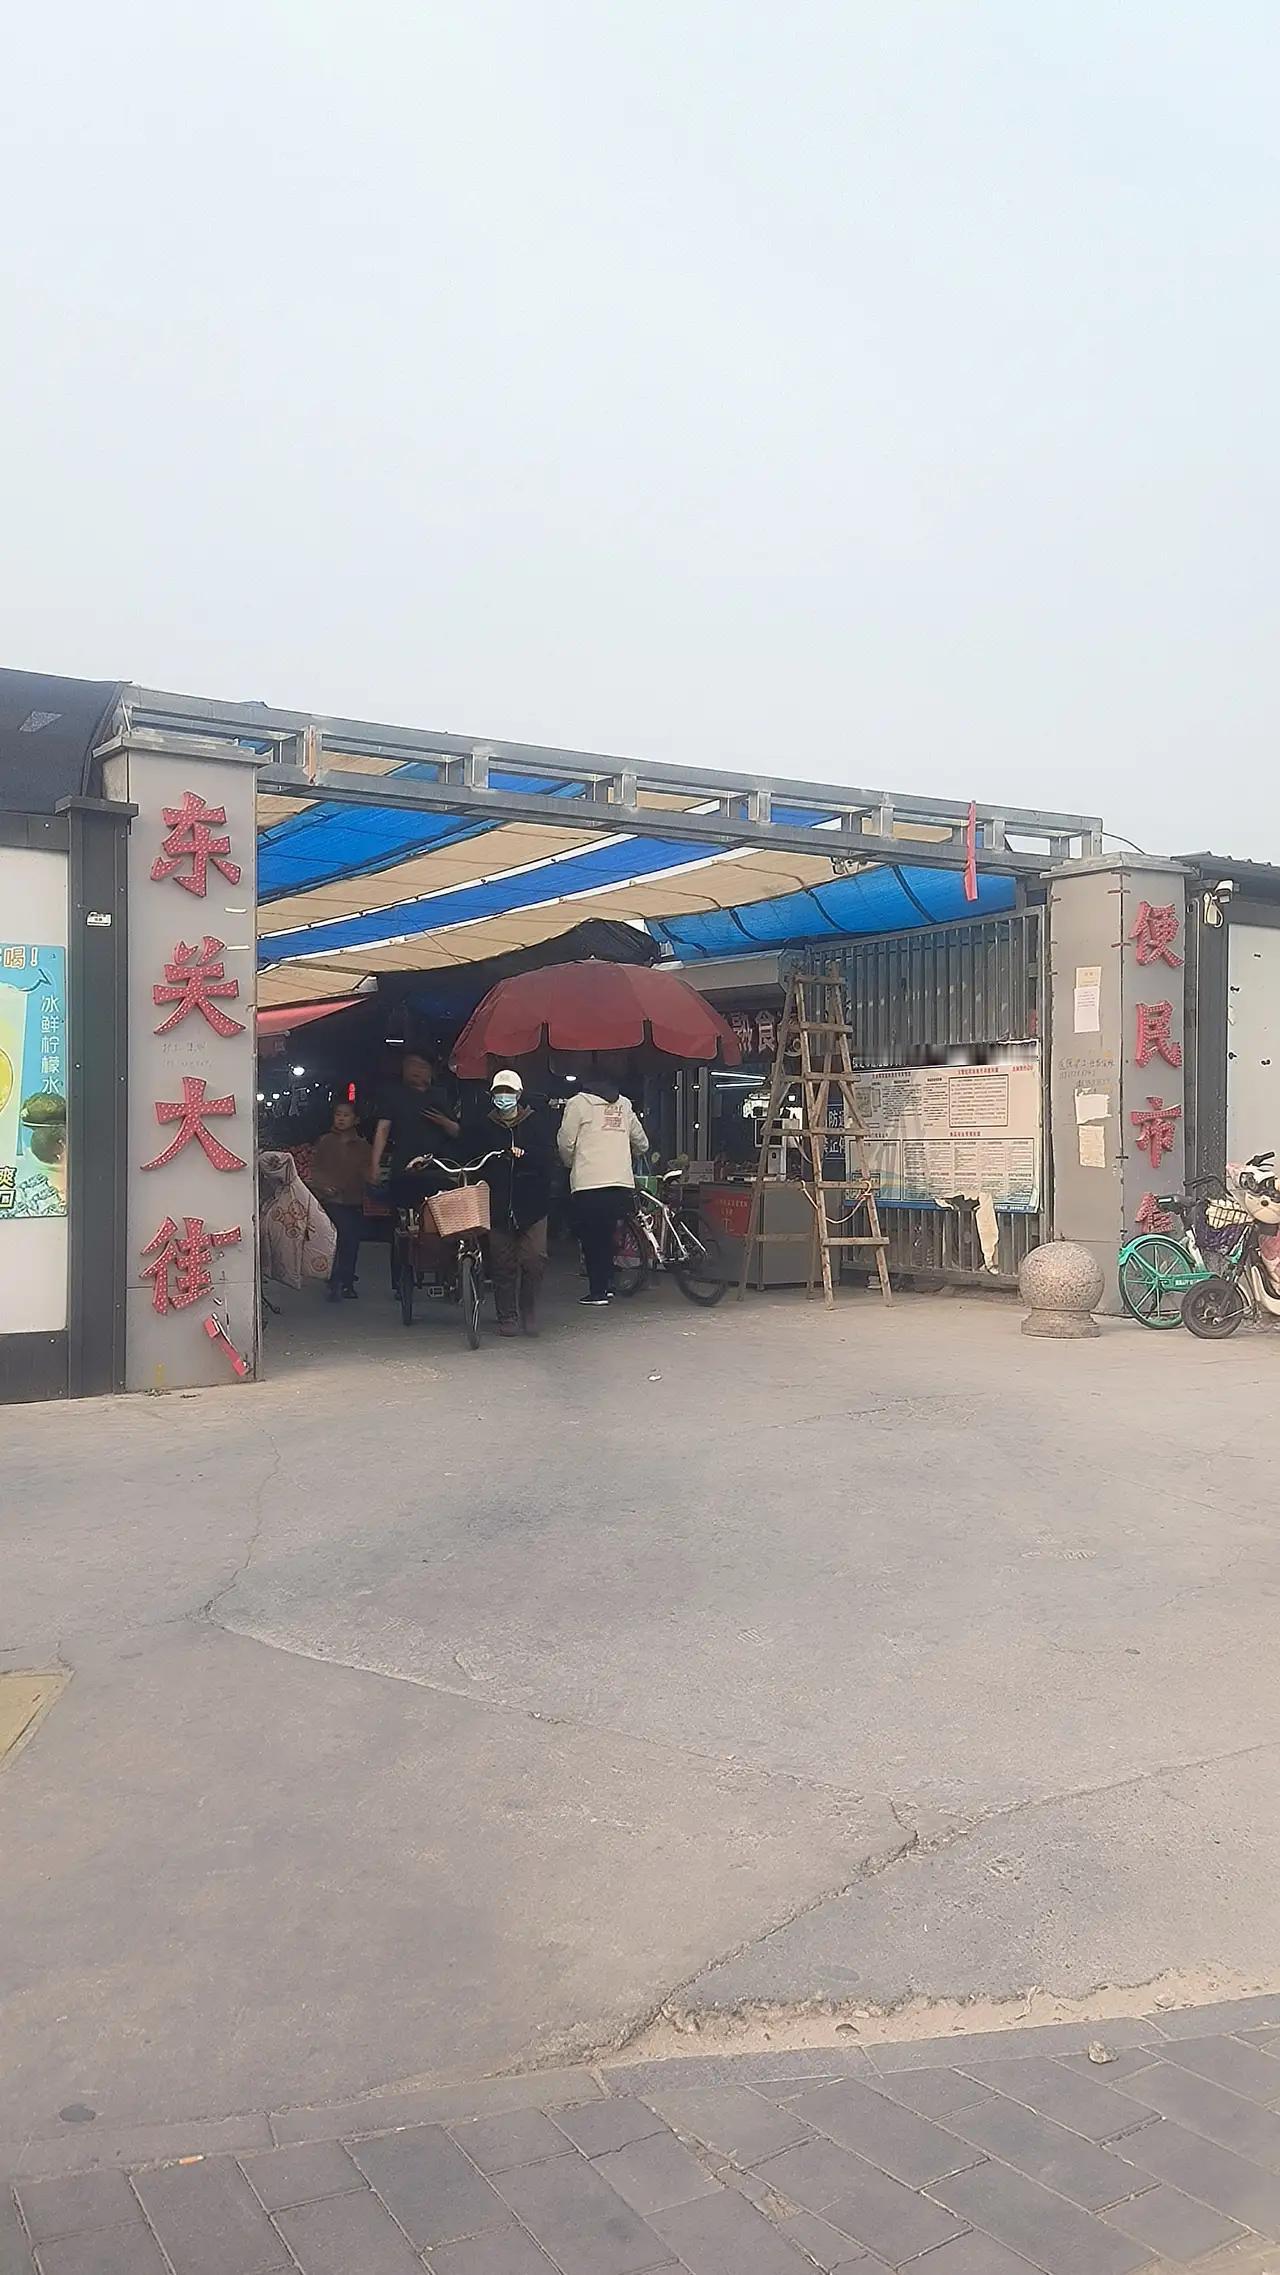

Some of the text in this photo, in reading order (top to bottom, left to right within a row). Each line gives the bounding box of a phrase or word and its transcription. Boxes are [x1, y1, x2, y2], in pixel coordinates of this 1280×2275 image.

[41, 994, 60, 1095] 冰鲜柠檬水
[140, 790, 248, 1376] 东关大街
